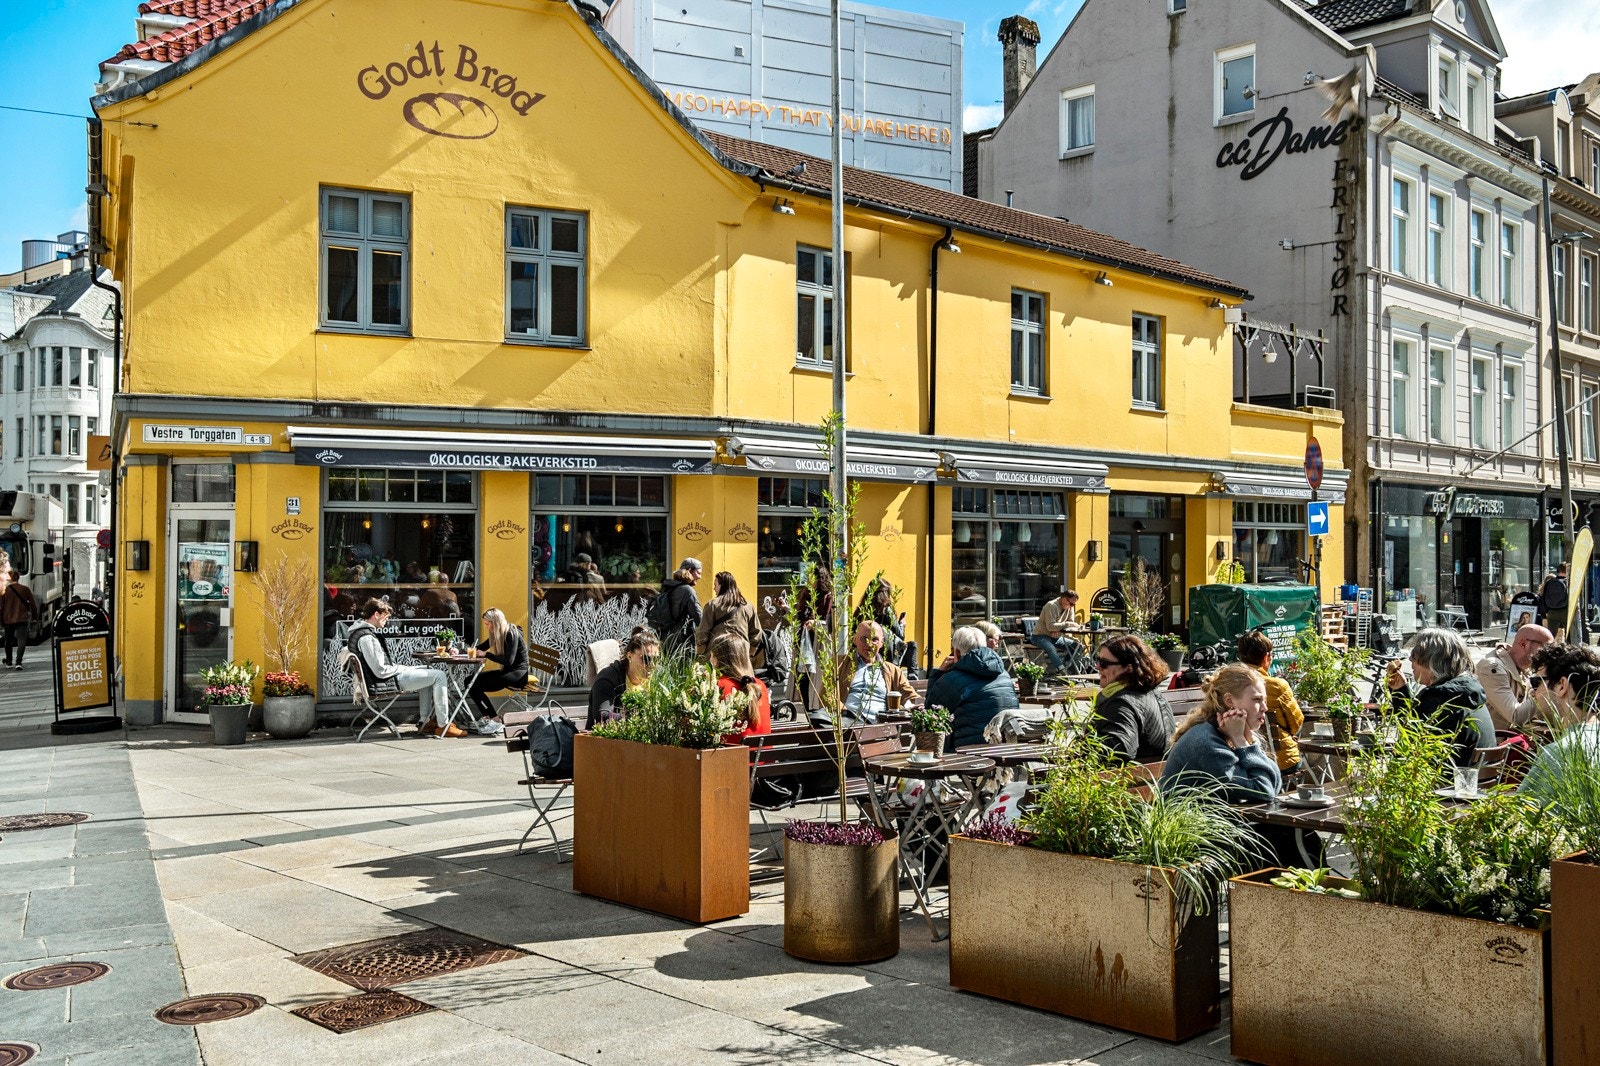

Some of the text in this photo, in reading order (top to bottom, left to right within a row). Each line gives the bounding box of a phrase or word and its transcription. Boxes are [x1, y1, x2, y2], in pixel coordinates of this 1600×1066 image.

[357, 40, 547, 117] Godt Brød
[685, 92, 709, 113] SO
[711, 98, 775, 121] HAPPY
[778, 106, 824, 127] THAT
[864, 118, 894, 138] ARE
[896, 122, 938, 144] HERE
[1330, 158, 1350, 317] FRISØR
[151, 426, 237, 442] Vestre Torggaten
[429, 452, 598, 469] ØKOLOGISK BAKEVERKSTED
[795, 459, 897, 476] ØKOLOGI AKEVERKSTED
[995, 471, 1073, 485] ØKOLOGISK BAKEVERKSTED
[288, 498, 299, 506] 31
[271, 519, 314, 534] Godt Brød
[487, 520, 526, 534] Godt Brød
[678, 522, 693, 535] Godt
[403, 625, 420, 634] Lev
[66, 659, 102, 672] SKOLE-
[67, 670, 103, 682] BOLLER
[1485, 936, 1505, 948] Godt
